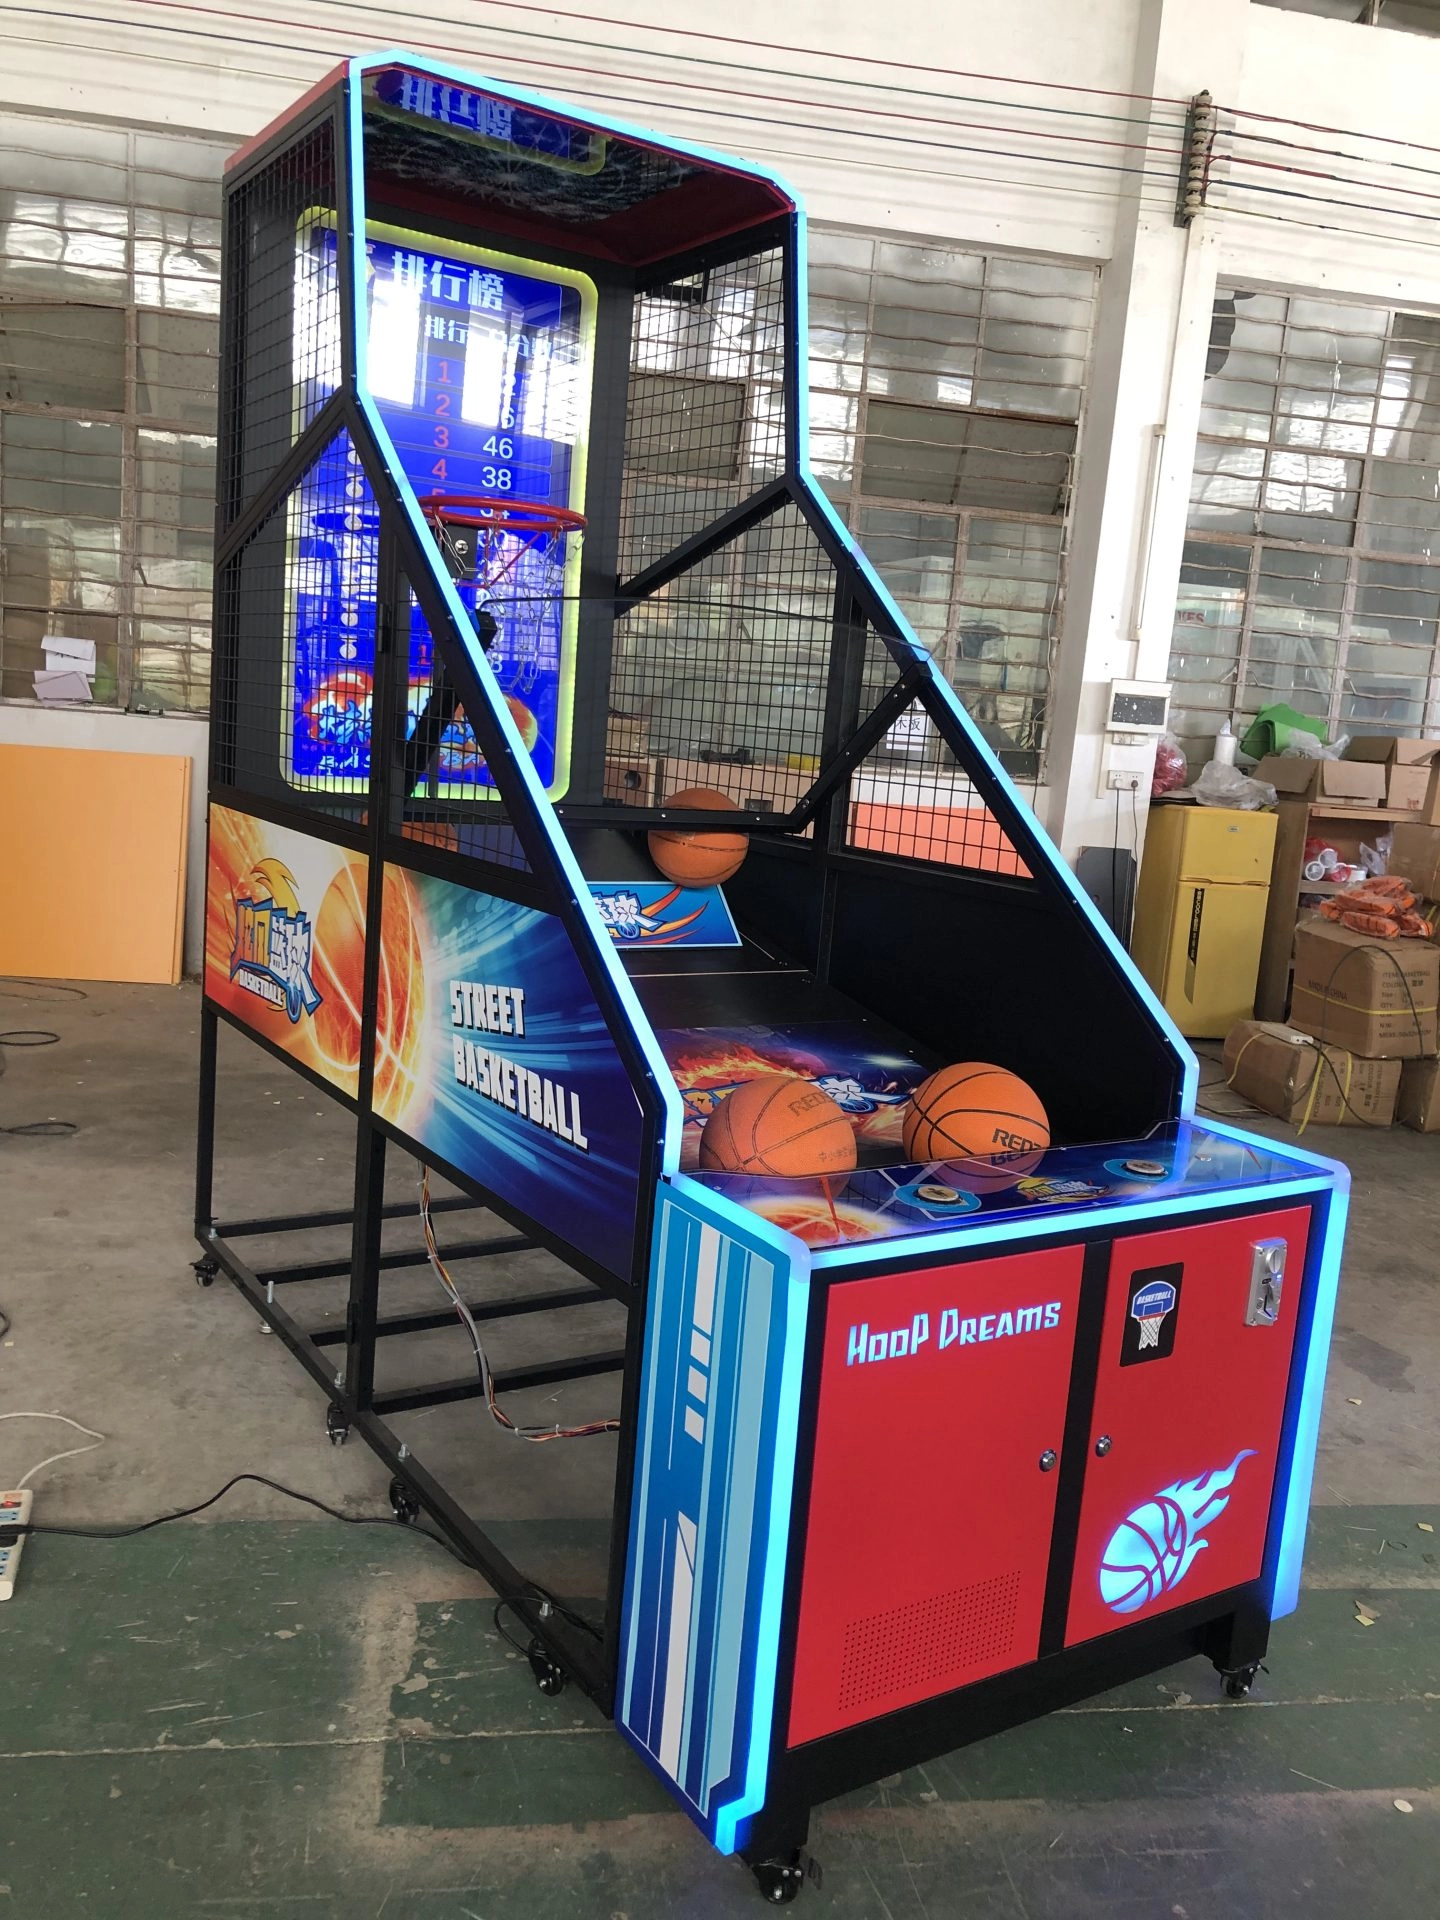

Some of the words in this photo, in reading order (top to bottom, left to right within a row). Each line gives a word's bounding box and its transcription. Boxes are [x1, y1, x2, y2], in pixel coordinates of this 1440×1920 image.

[391, 251, 504, 311] 排行榜
[437, 361, 451, 384] 1
[434, 393, 450, 417] 2
[433, 425, 449, 449] 3
[482, 435, 513, 459] 46
[431, 458, 448, 480] 4
[481, 466, 512, 490] 38
[238, 967, 284, 1007] BASKETBALL
[450, 979, 525, 1038] STREET
[453, 1033, 589, 1154] BASKETBALL
[787, 1091, 834, 1117] RED
[1136, 1289, 1172, 1305] BASKETBALL
